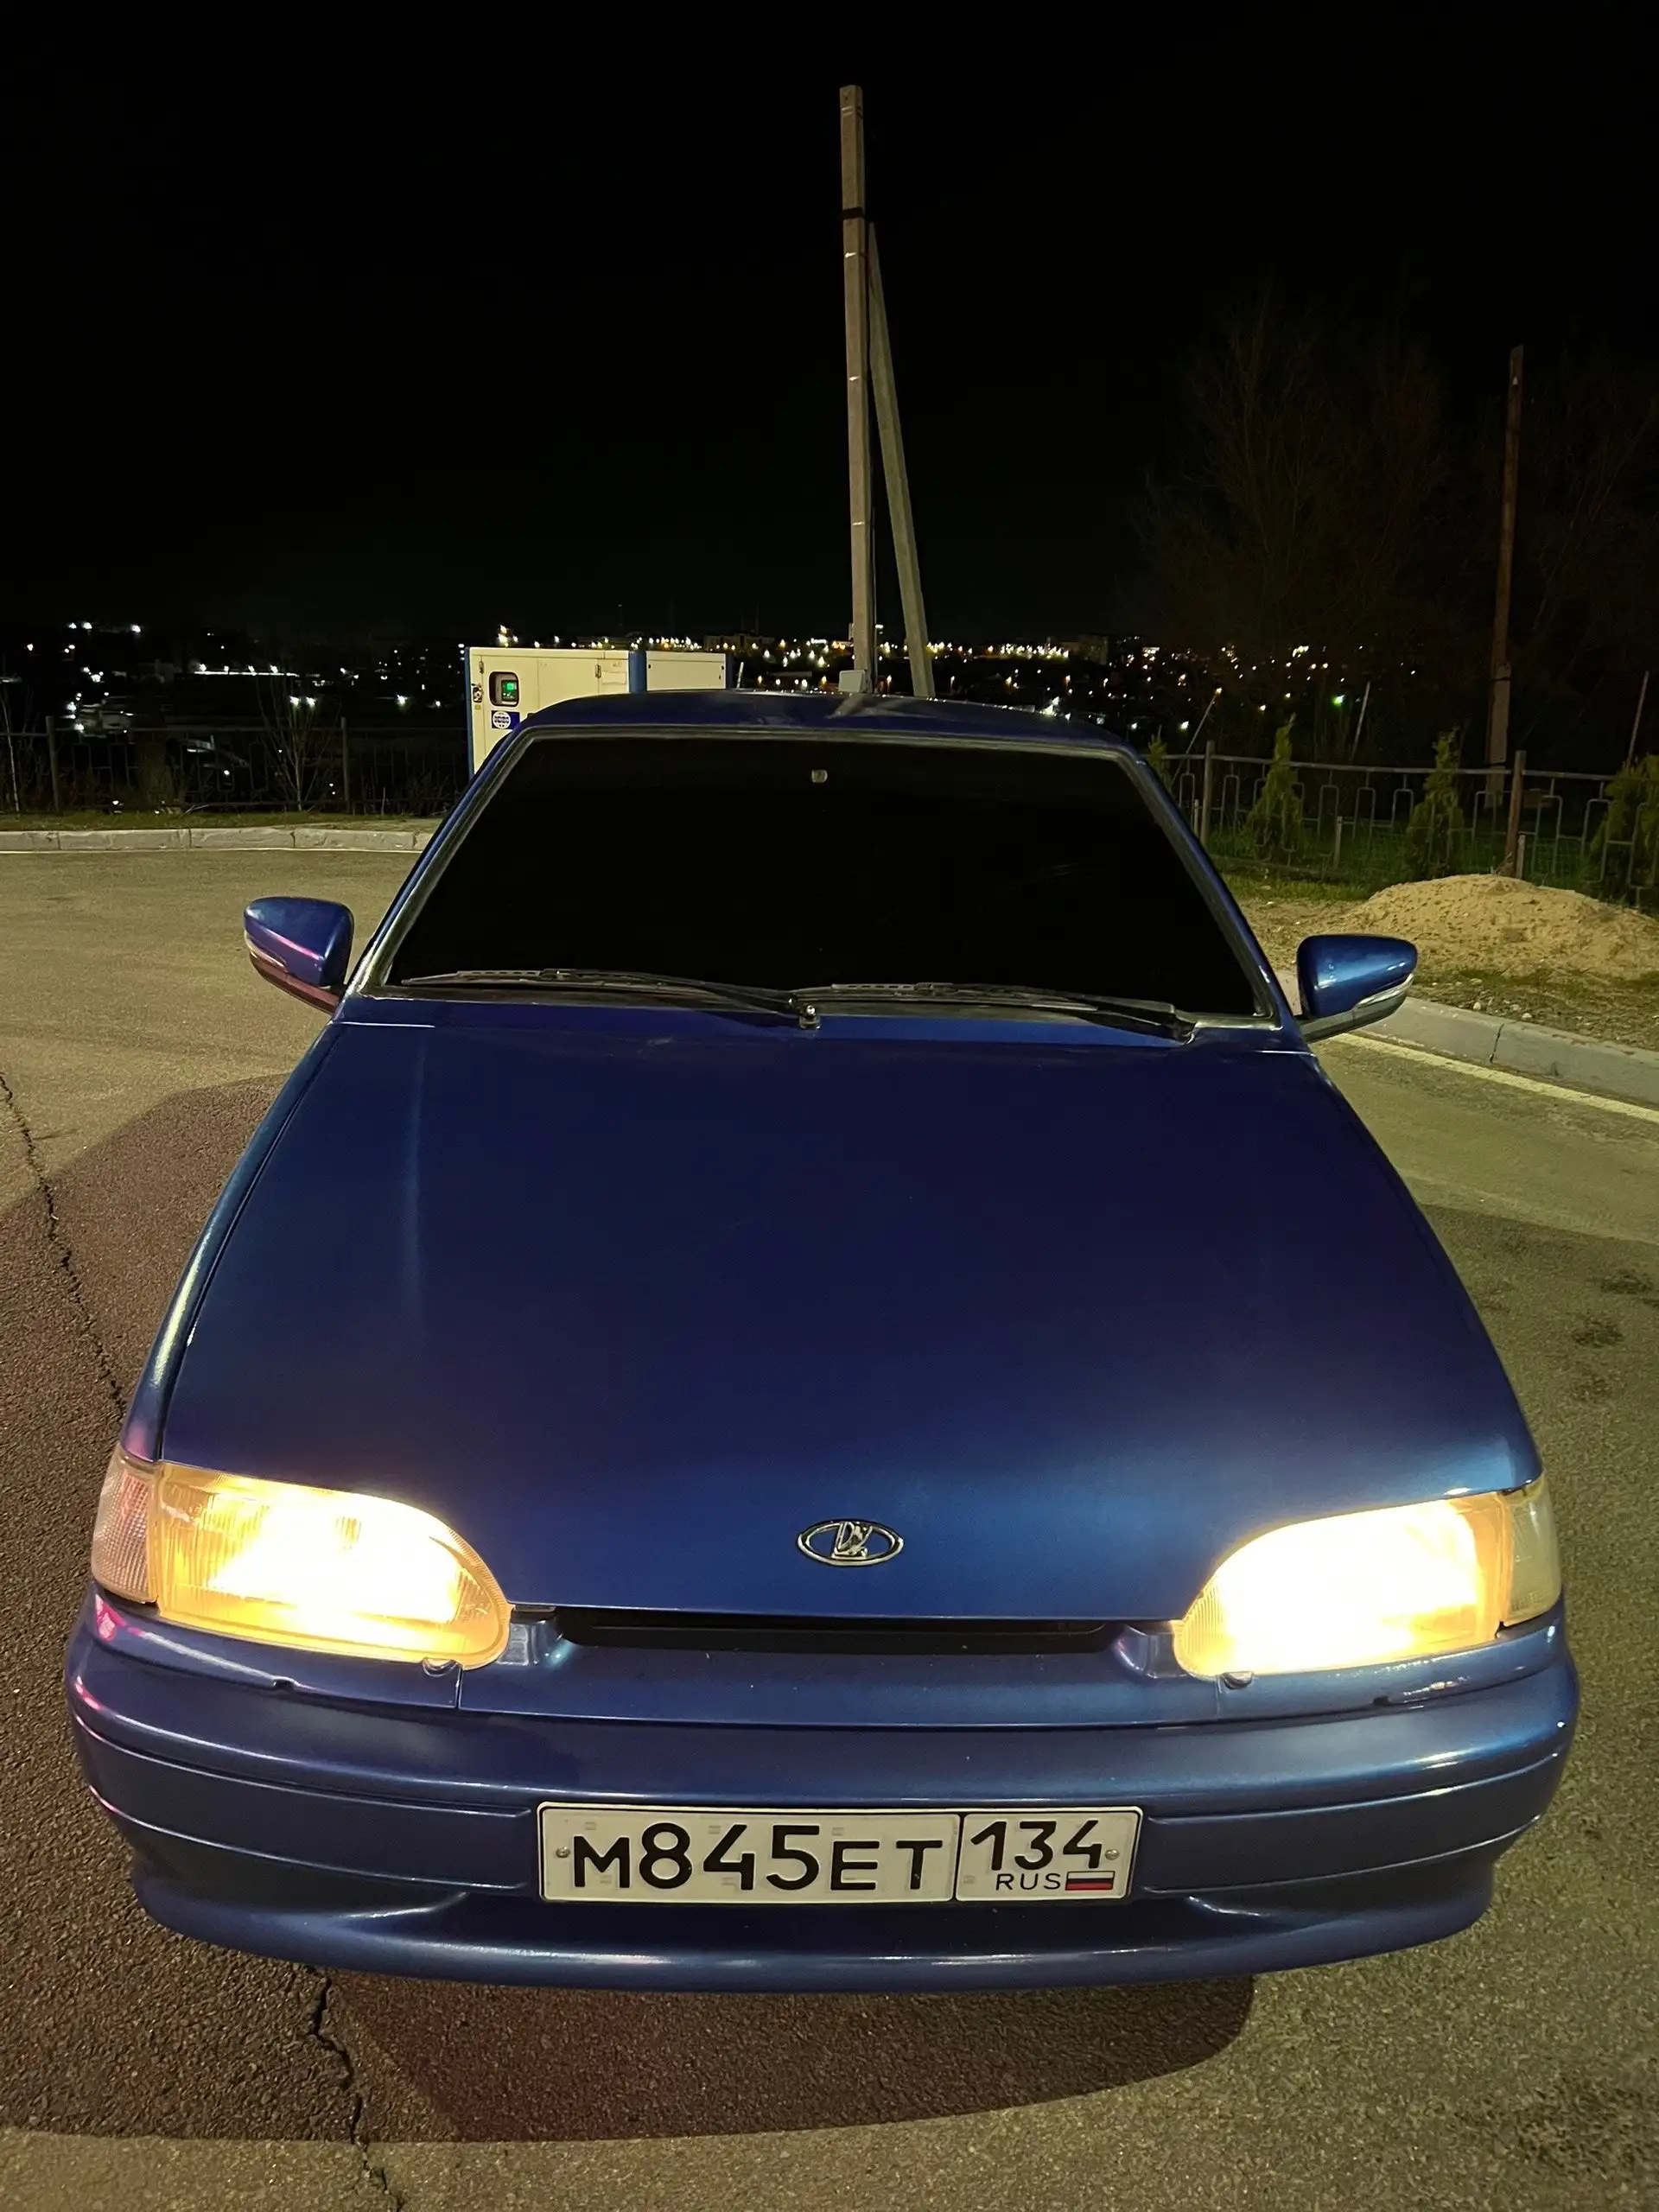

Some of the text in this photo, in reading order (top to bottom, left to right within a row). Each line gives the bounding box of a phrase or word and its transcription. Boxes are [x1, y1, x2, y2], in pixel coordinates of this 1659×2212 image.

[572, 1820, 1103, 1891] М845ЕТ 134
[995, 1872, 1061, 1891] RUS
